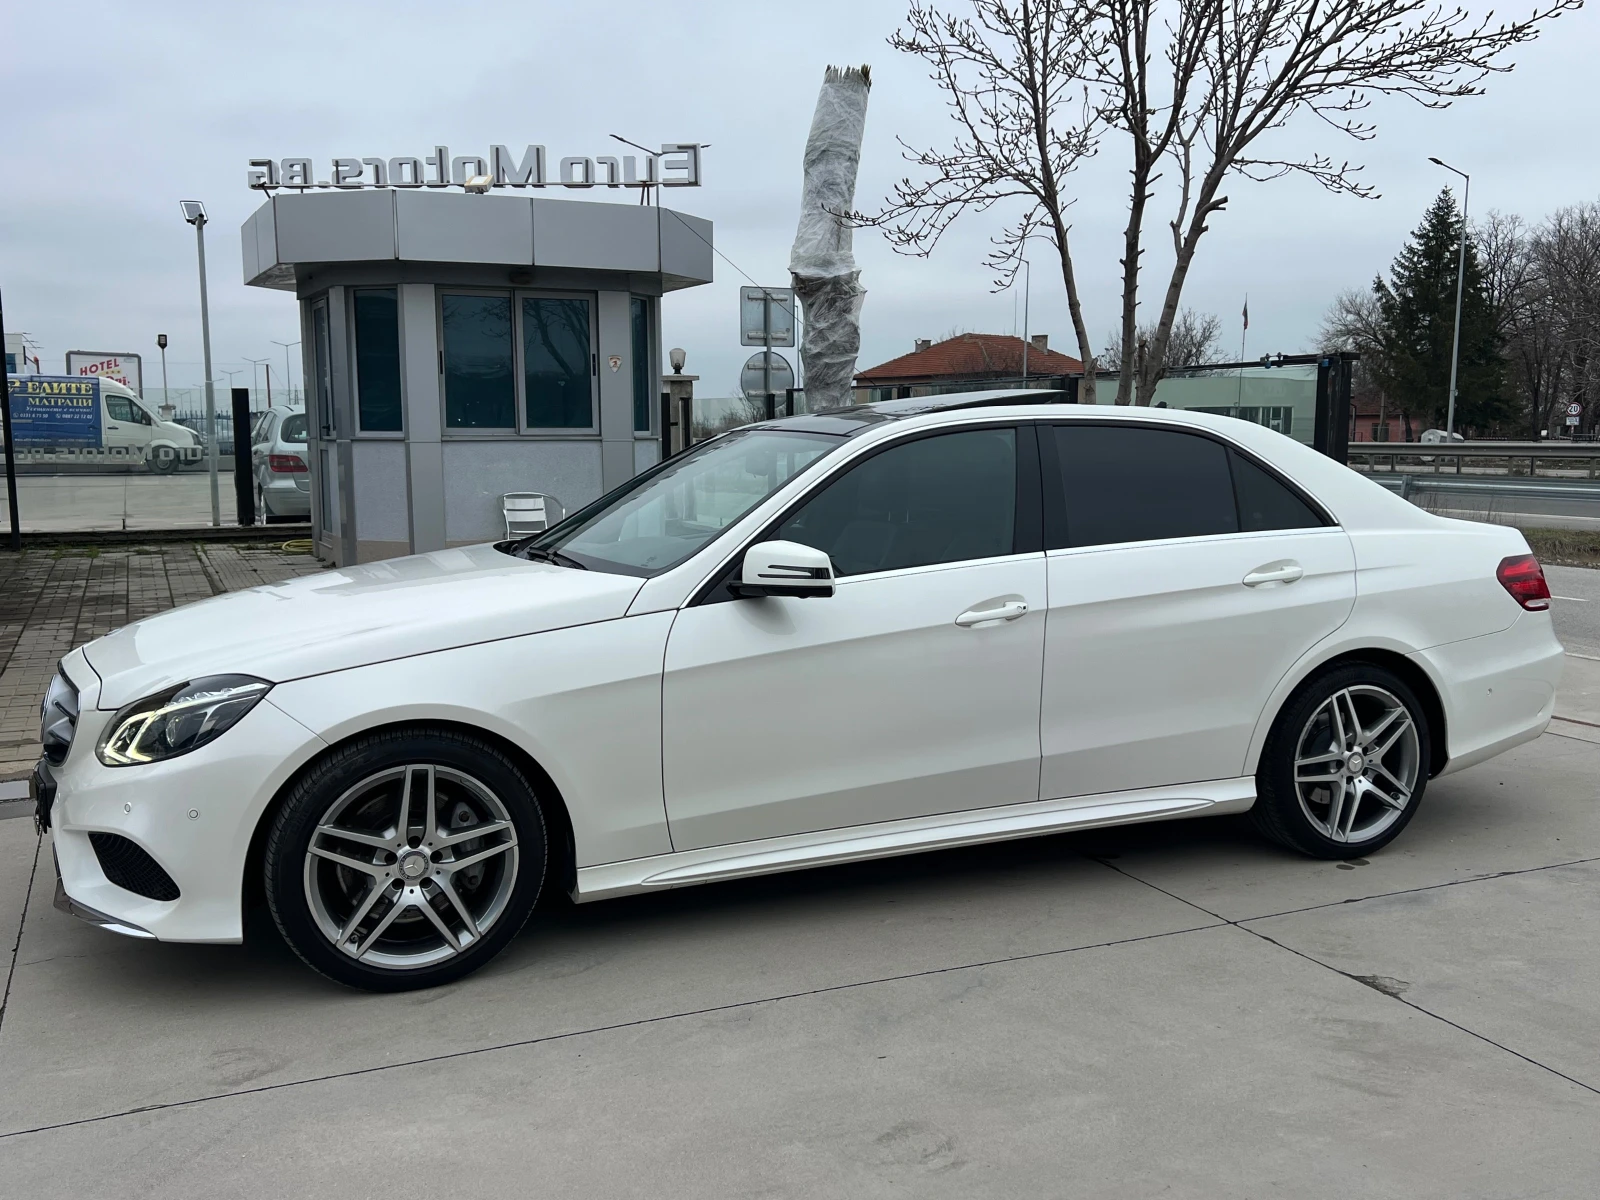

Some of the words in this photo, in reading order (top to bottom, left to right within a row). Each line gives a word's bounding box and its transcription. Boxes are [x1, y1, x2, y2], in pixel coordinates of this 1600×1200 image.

[80, 358, 119, 376] HOTEL
[26, 381, 93, 395] ЕЛИТЕ
[28, 397, 93, 407] МАТРАЦИ
[1569, 405, 1579, 413] 20
